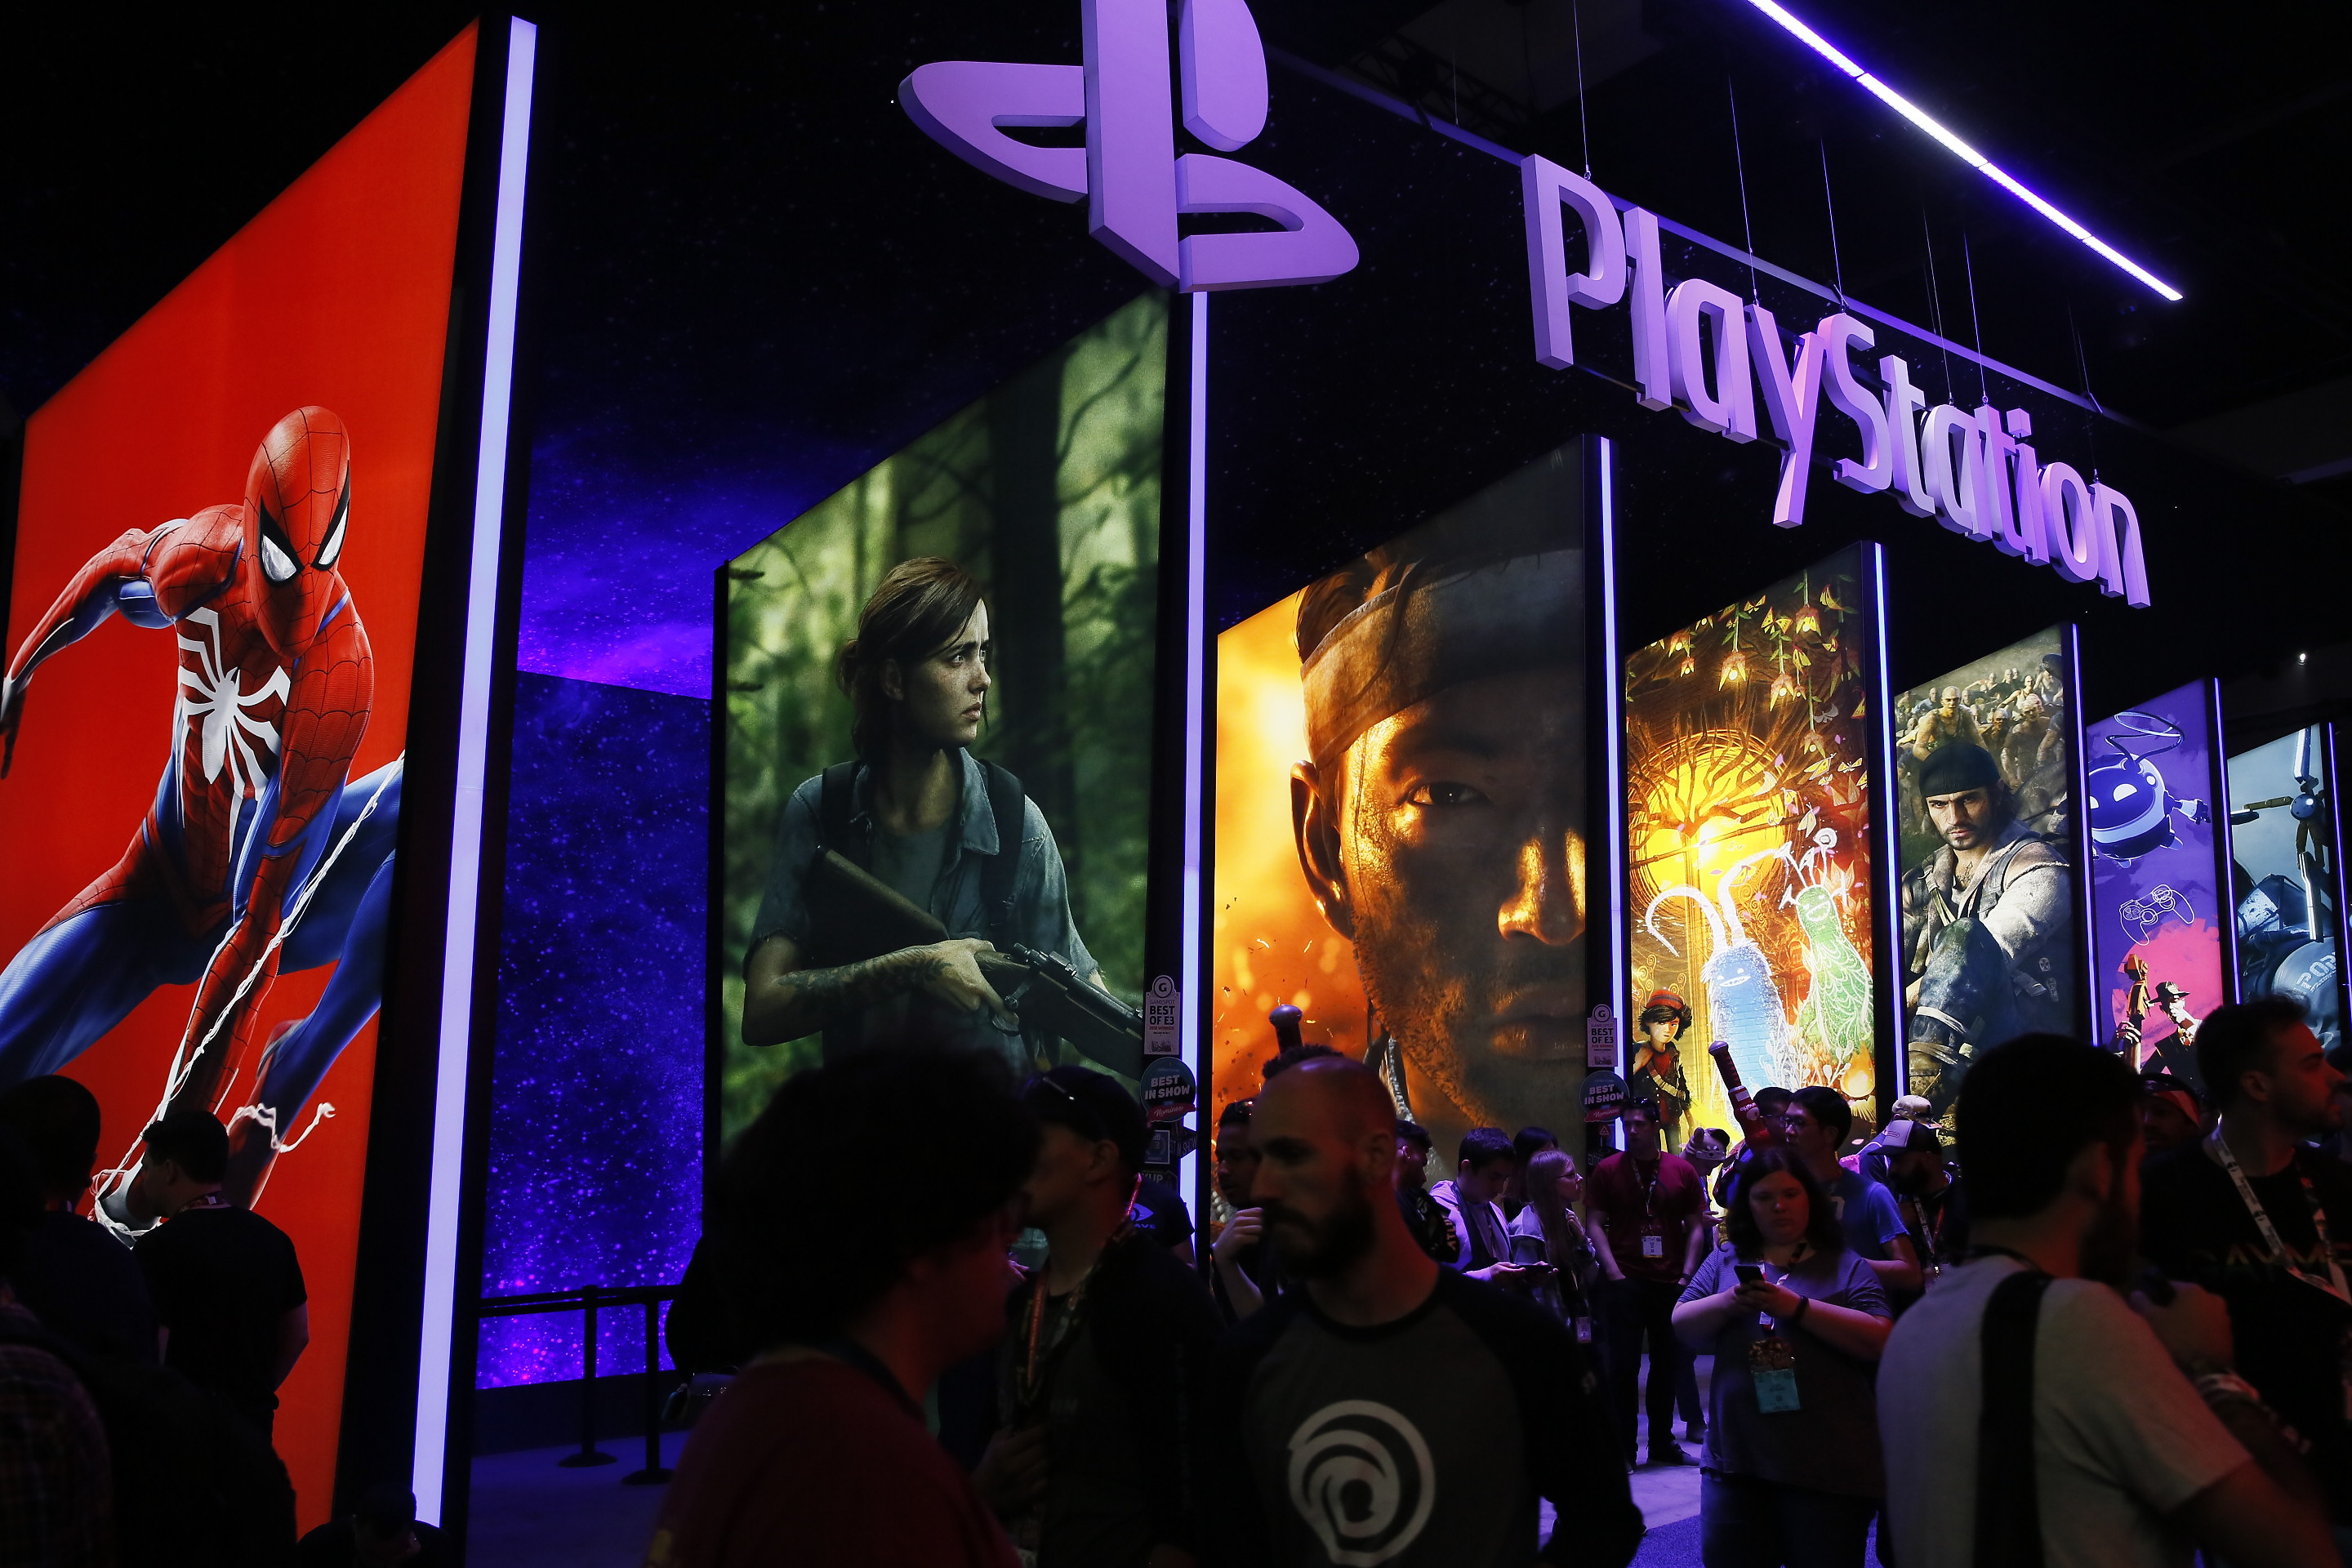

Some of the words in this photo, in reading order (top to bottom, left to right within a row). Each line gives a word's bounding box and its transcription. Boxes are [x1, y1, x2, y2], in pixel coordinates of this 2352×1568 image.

[1520, 153, 2151, 609] PlayStation
[1149, 1005, 1175, 1015] BEST
[1149, 1015, 1162, 1026] OF
[1164, 1015, 1175, 1026] E3
[1591, 1027, 1614, 1036] BEST
[1591, 1036, 1602, 1044] OF
[1604, 1036, 1614, 1044] E3
[1151, 1075, 1181, 1087] BEST
[1144, 1089, 1156, 1100] IN
[1157, 1085, 1191, 1098] SHOW
[1588, 1084, 1615, 1095] BEST
[1584, 1097, 1595, 1105] IN
[1595, 1091, 1624, 1103] SHOW
